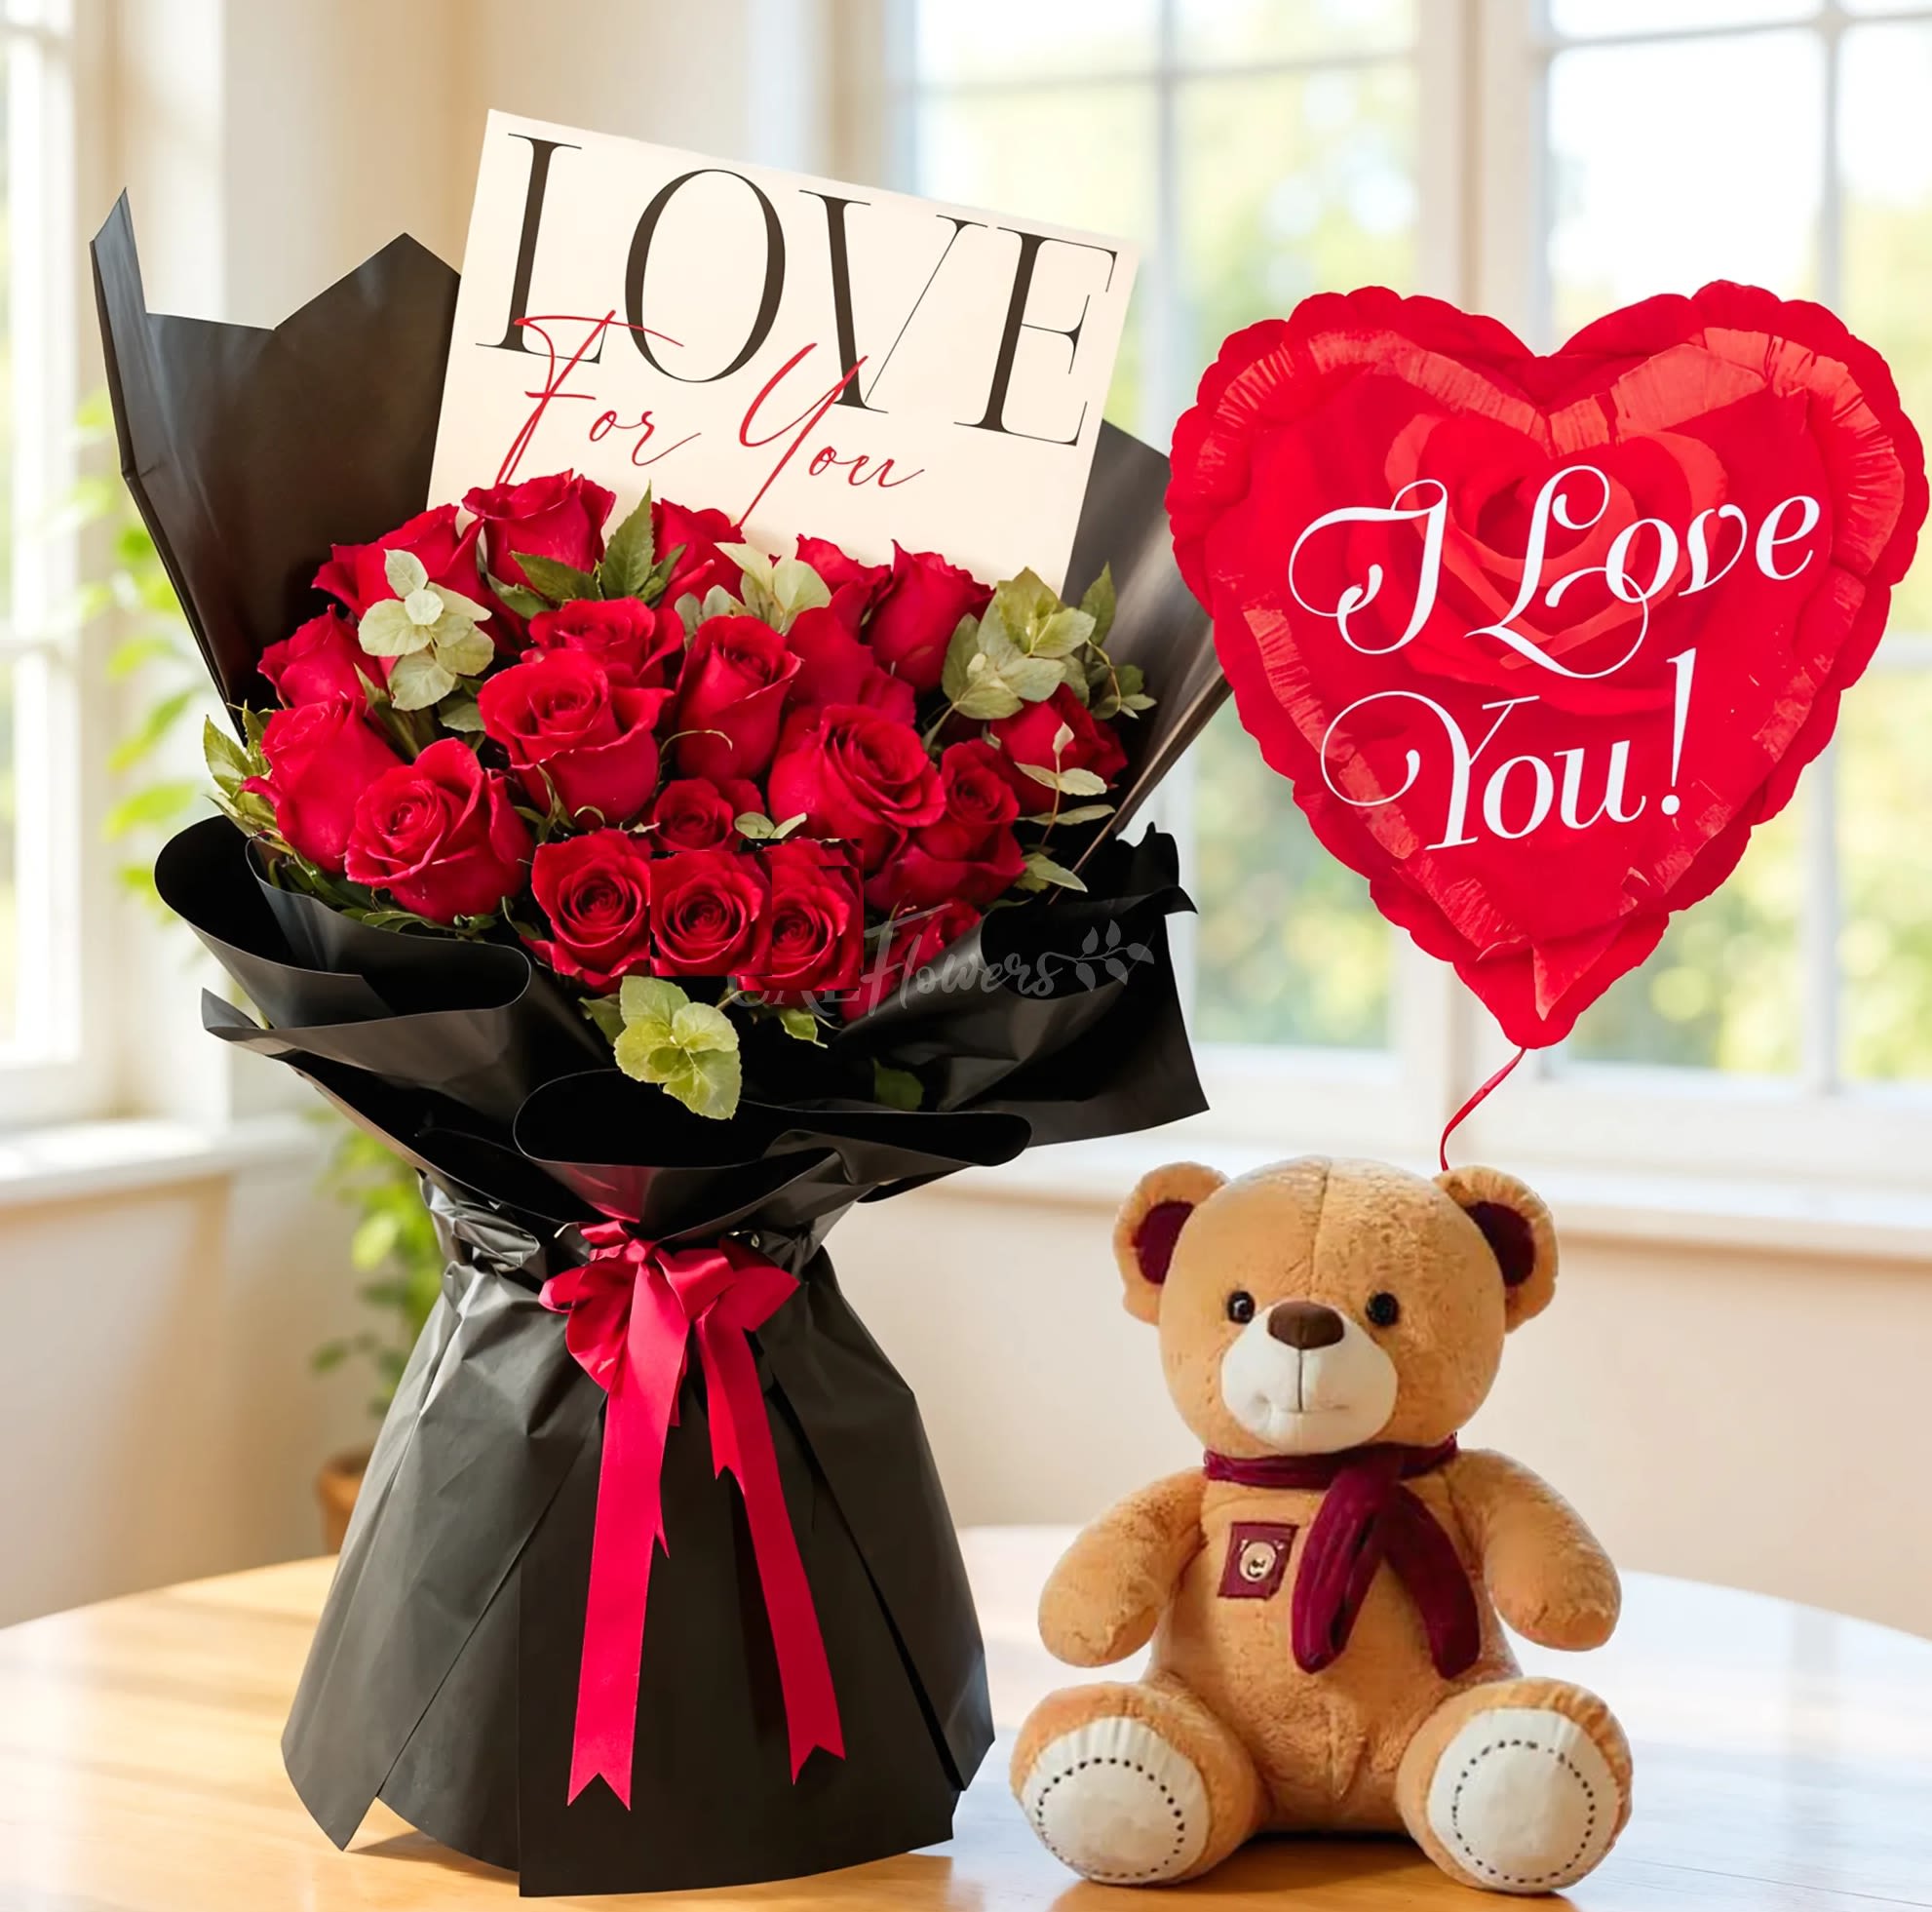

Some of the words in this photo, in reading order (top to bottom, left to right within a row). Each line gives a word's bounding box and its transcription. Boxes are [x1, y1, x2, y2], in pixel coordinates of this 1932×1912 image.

[475, 133, 1118, 447] LOVE
[494, 309, 702, 486] For
[737, 342, 926, 527] You
[1288, 478, 1449, 655] I
[1463, 464, 1821, 680] Love
[1320, 647, 1697, 851] You!
